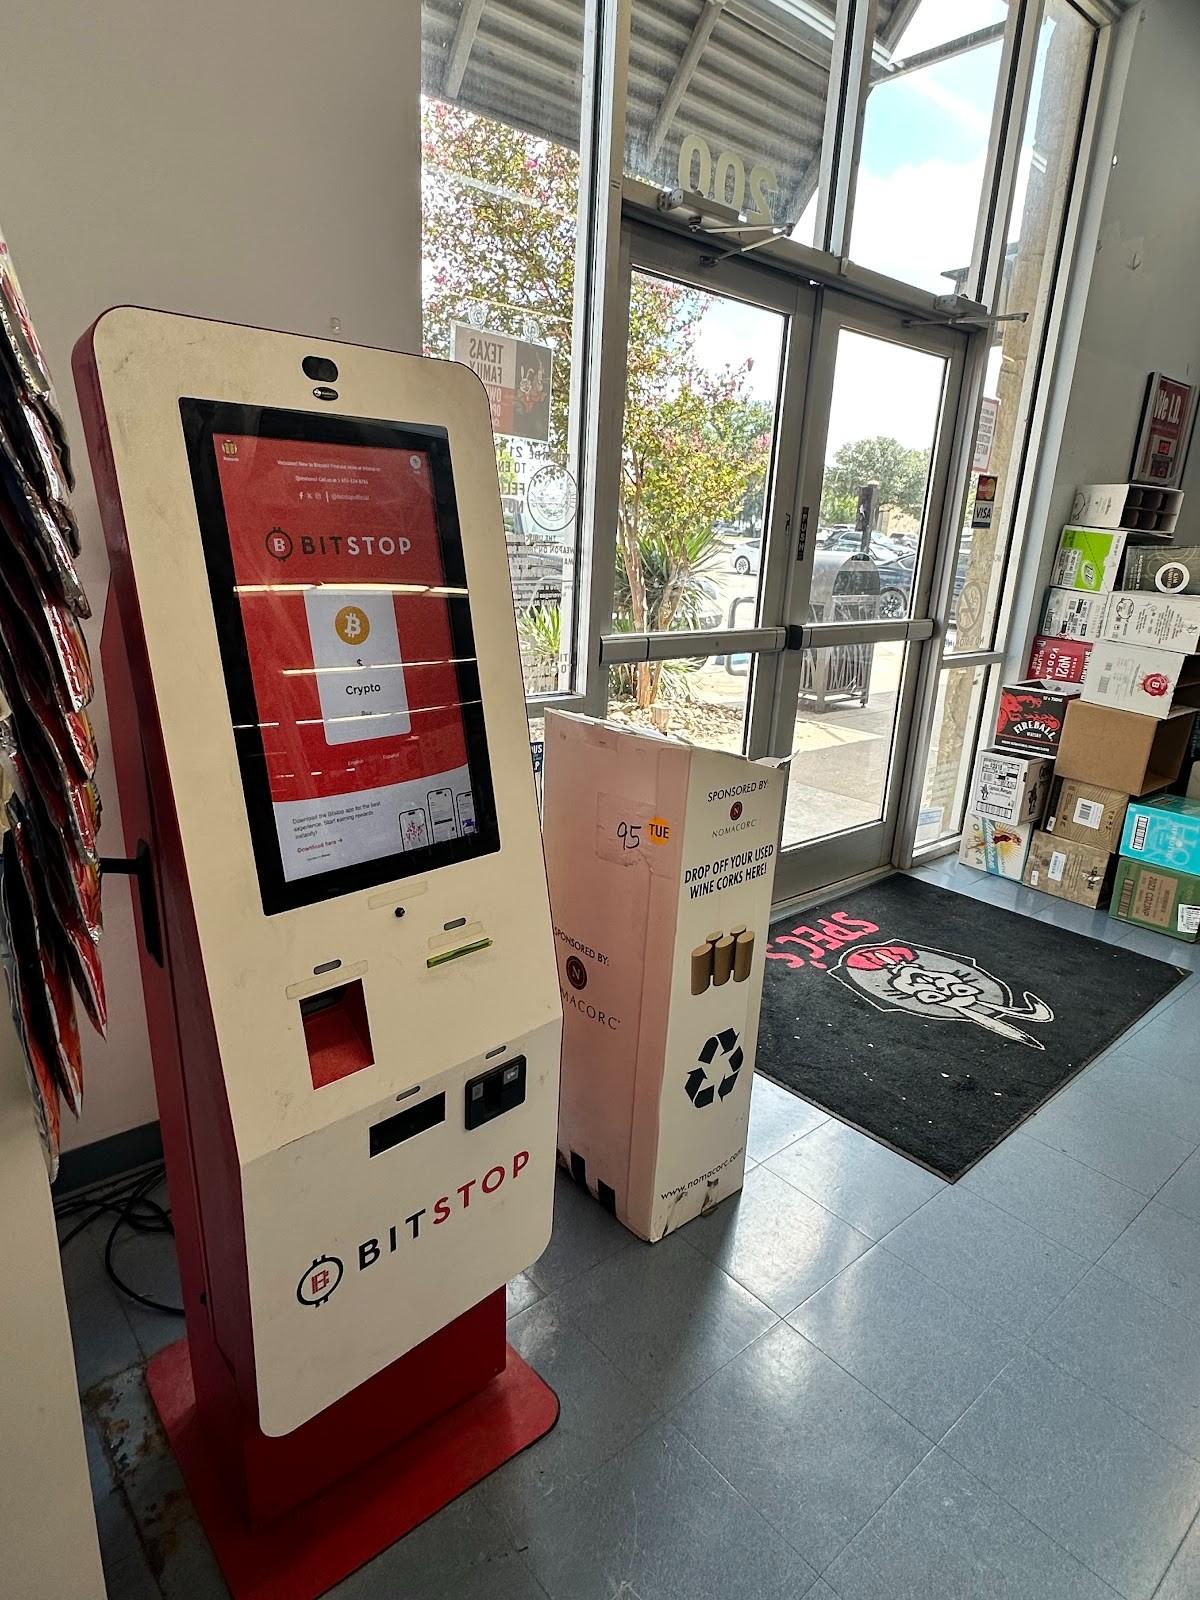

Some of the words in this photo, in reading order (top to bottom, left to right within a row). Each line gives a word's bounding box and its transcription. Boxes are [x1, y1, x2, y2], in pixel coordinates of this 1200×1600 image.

[976, 507, 991, 519] VISA
[301, 536, 412, 556] BITSTOP
[798, 513, 808, 551] PUSH
[1045, 647, 1060, 680] VODKA
[346, 683, 381, 696] Crypto
[1013, 720, 1056, 740] FIREBALL
[707, 782, 757, 803] SPONSORED
[617, 821, 642, 850] 95
[649, 823, 670, 839] TUE
[711, 819, 757, 838] NOMACORC
[684, 861, 711, 885] DROP
[712, 857, 729, 877] OFF
[729, 851, 753, 873] YOUR
[754, 844, 775, 864] USED
[689, 877, 715, 900] WINE
[716, 871, 743, 892] CORKS
[745, 863, 768, 884] HERE!
[554, 926, 596, 959] SPONSORED
[660, 1147, 744, 1200] www.nomacorc.com
[358, 1150, 530, 1271] BITSTOP
